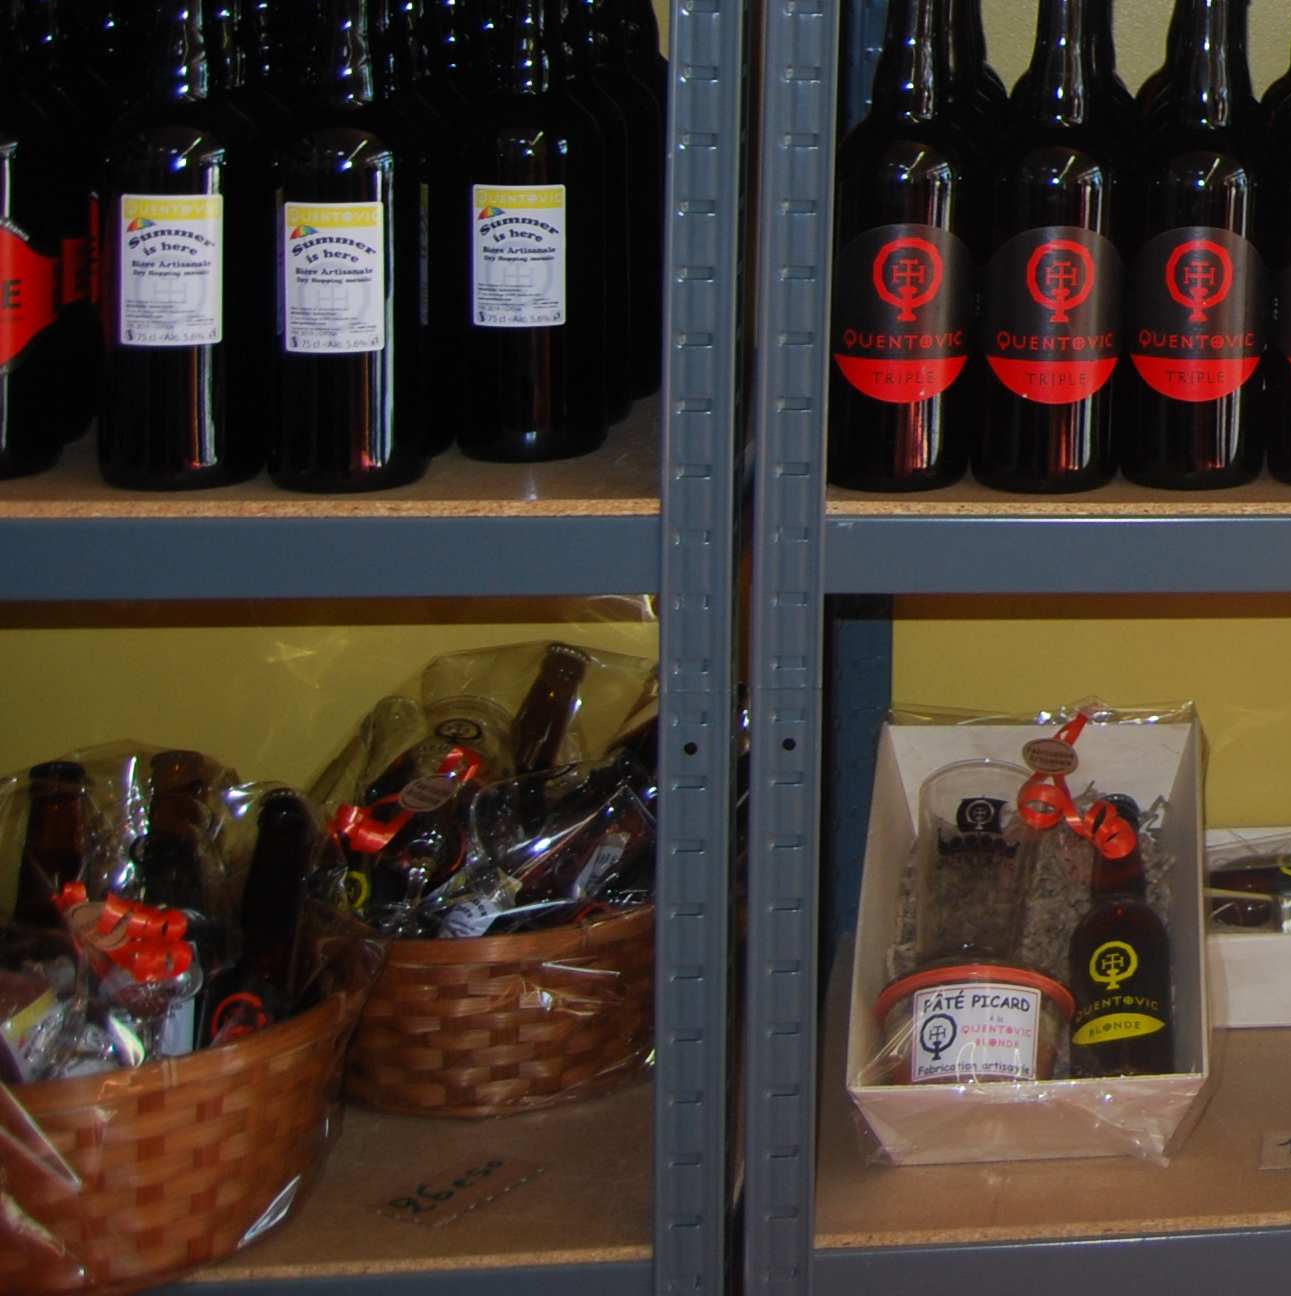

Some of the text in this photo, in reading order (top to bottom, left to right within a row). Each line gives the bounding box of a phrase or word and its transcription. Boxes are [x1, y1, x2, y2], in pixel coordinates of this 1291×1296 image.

[292, 235, 376, 256] Summer
[306, 249, 359, 264] is here
[844, 329, 963, 350] QUENTOVIC
[996, 331, 1112, 351] QUENTOVIC
[1138, 329, 1255, 351] QUENTOVIC
[873, 370, 935, 385] TRIPLE
[1025, 372, 1088, 386] TRIPLE
[1166, 370, 1226, 385] TRIPLE
[923, 991, 1031, 1013] PÂTÉ PICARD
[1077, 996, 1159, 1023] QUENTOVIC
[1089, 1021, 1142, 1036] BLONDE
